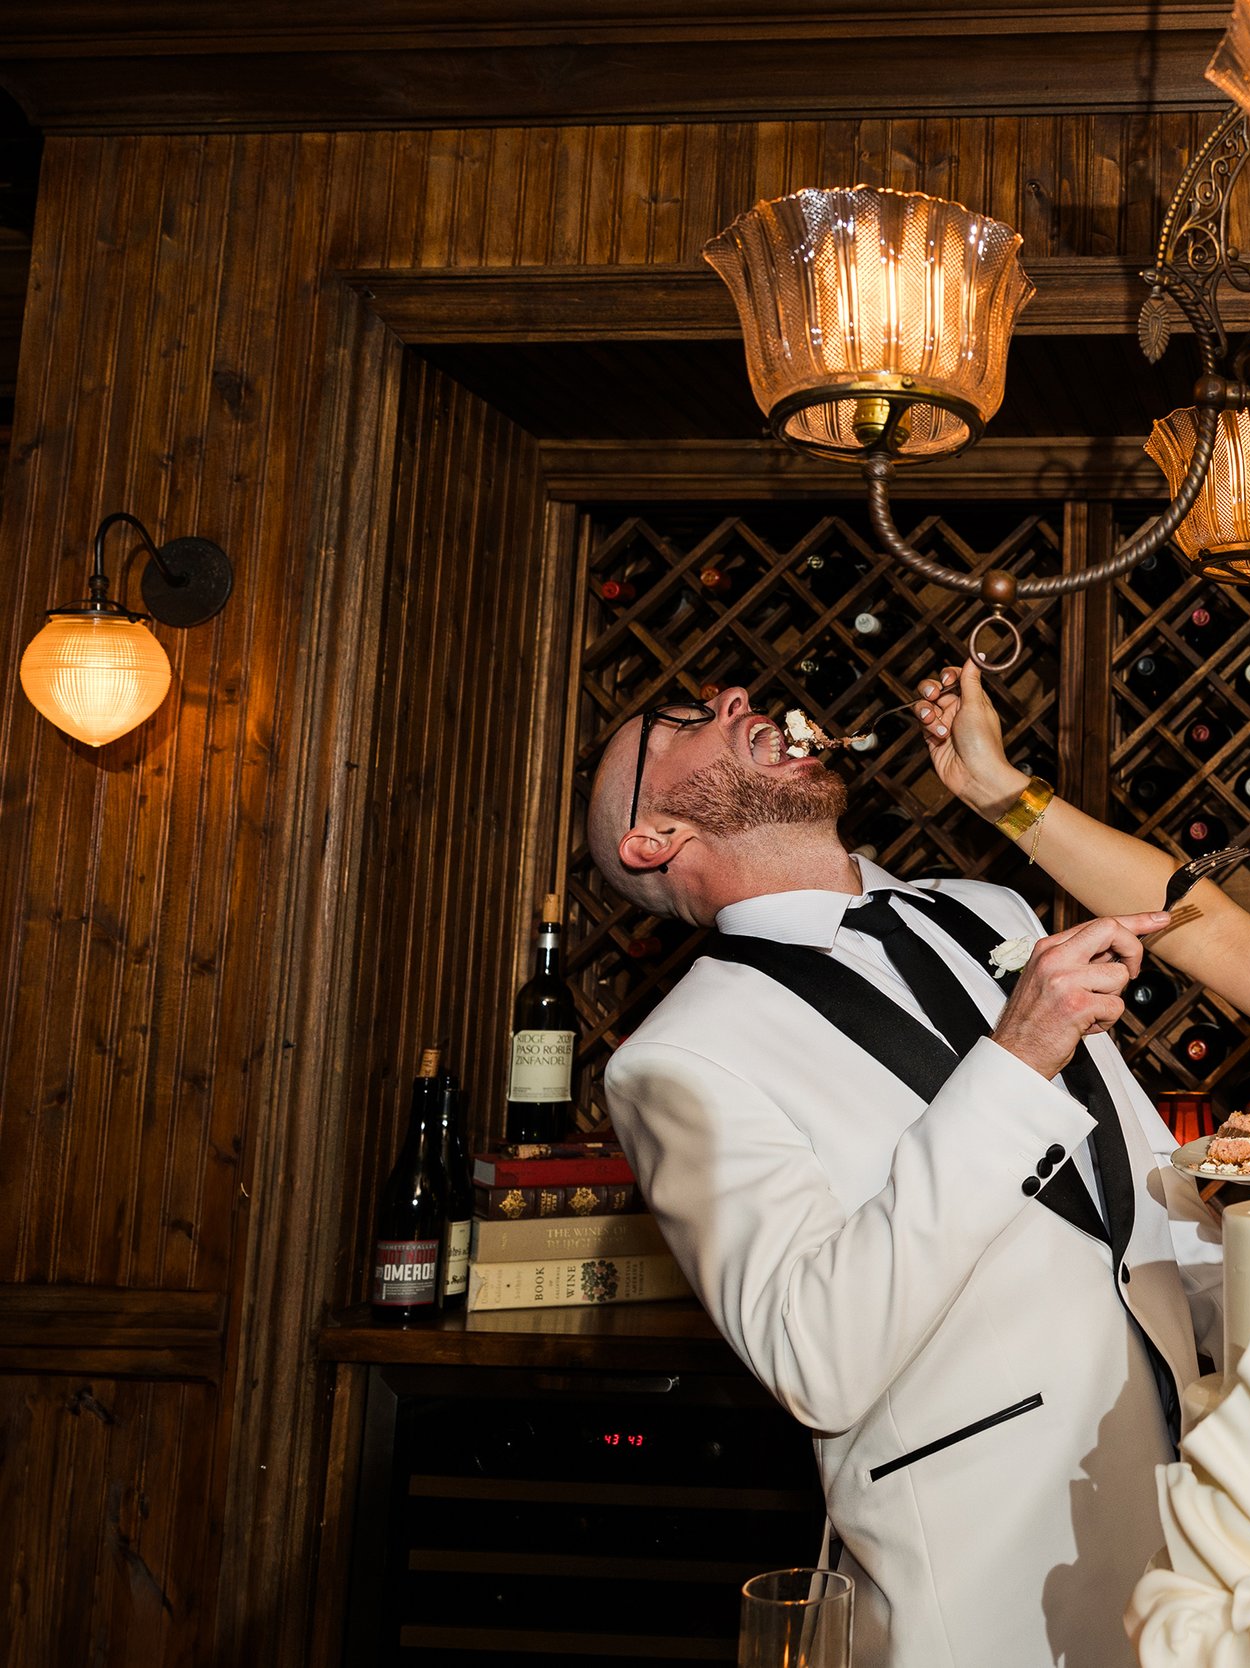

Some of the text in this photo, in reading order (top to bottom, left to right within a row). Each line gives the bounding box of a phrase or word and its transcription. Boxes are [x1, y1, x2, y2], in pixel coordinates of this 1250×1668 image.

[516, 1034, 545, 1043] RIDGE
[516, 1045, 572, 1055] PASO ROBLES
[516, 1056, 565, 1065] ZINFANDEL
[546, 1228, 571, 1238] THE
[573, 1226, 609, 1237] WINES
[383, 1263, 431, 1281] OMERO
[534, 1267, 545, 1301] BOOK
[566, 1265, 577, 1299] WINE
[604, 1434, 643, 1446] 43 43
